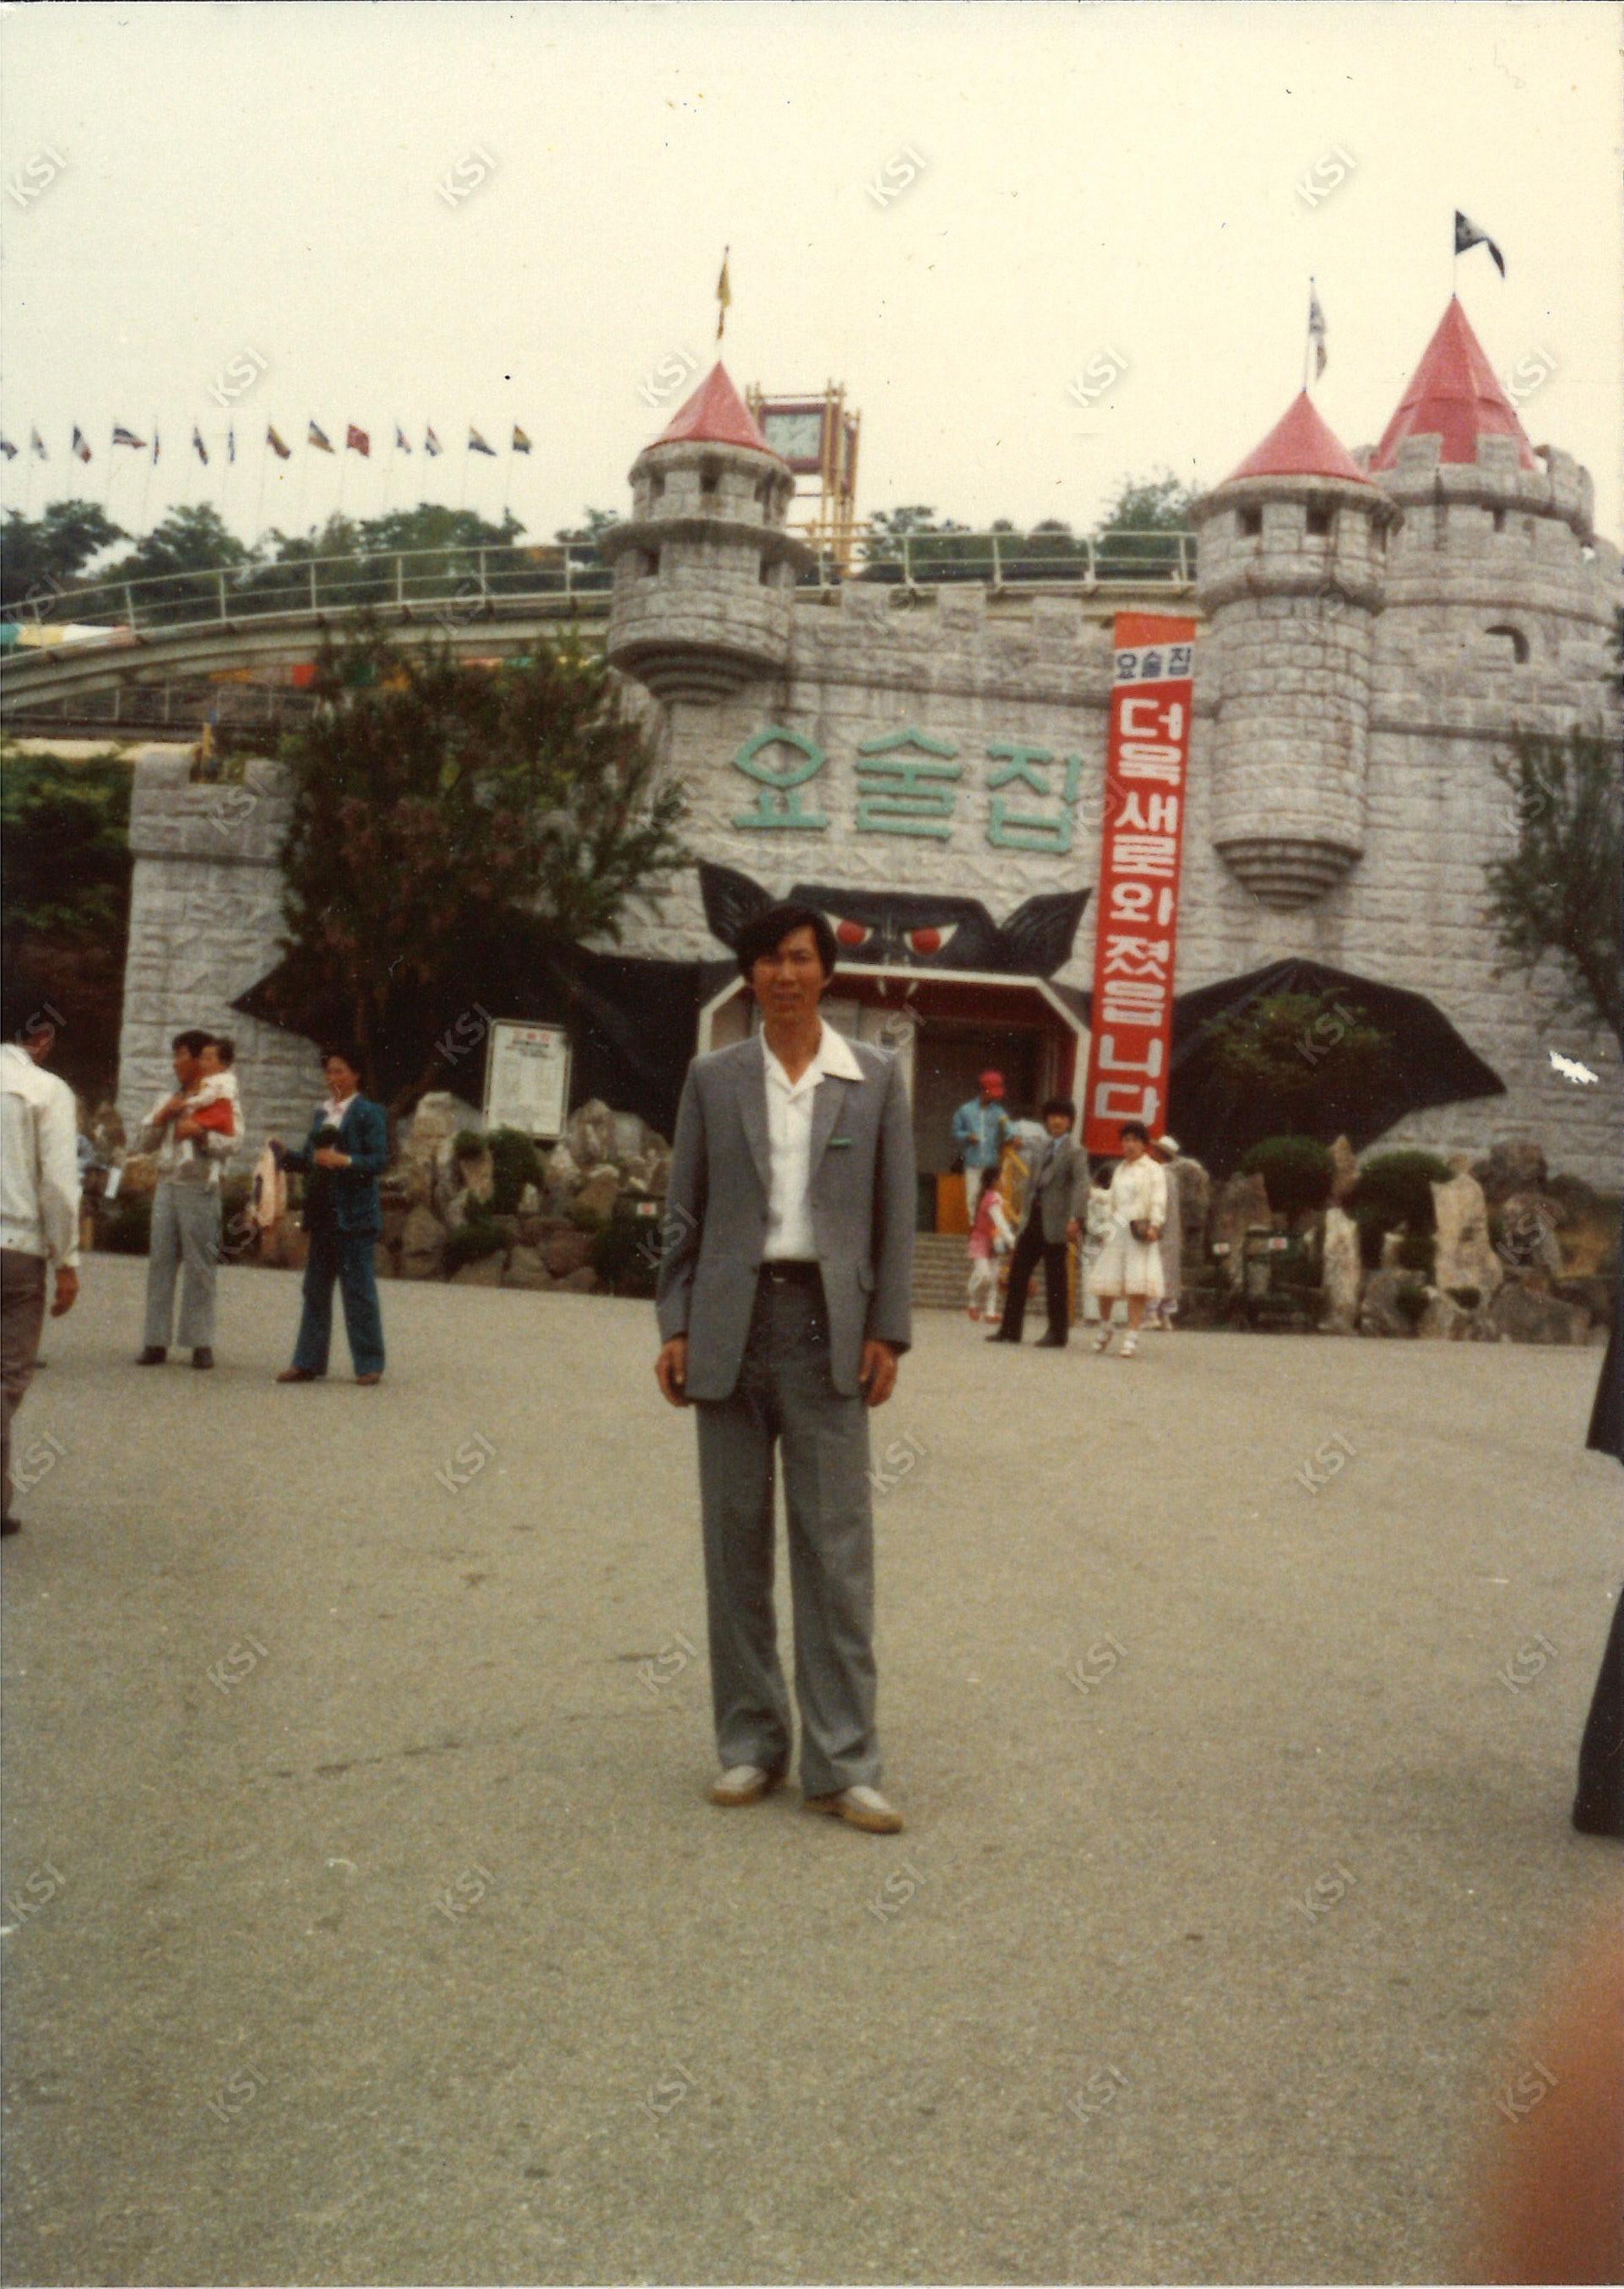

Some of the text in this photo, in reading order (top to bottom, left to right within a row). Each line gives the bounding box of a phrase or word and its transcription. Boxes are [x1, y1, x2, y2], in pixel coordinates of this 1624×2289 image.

[1116, 647, 1192, 679] 요술집
[1118, 698, 1183, 786] 더욱
[731, 726, 1084, 854] 요술집
